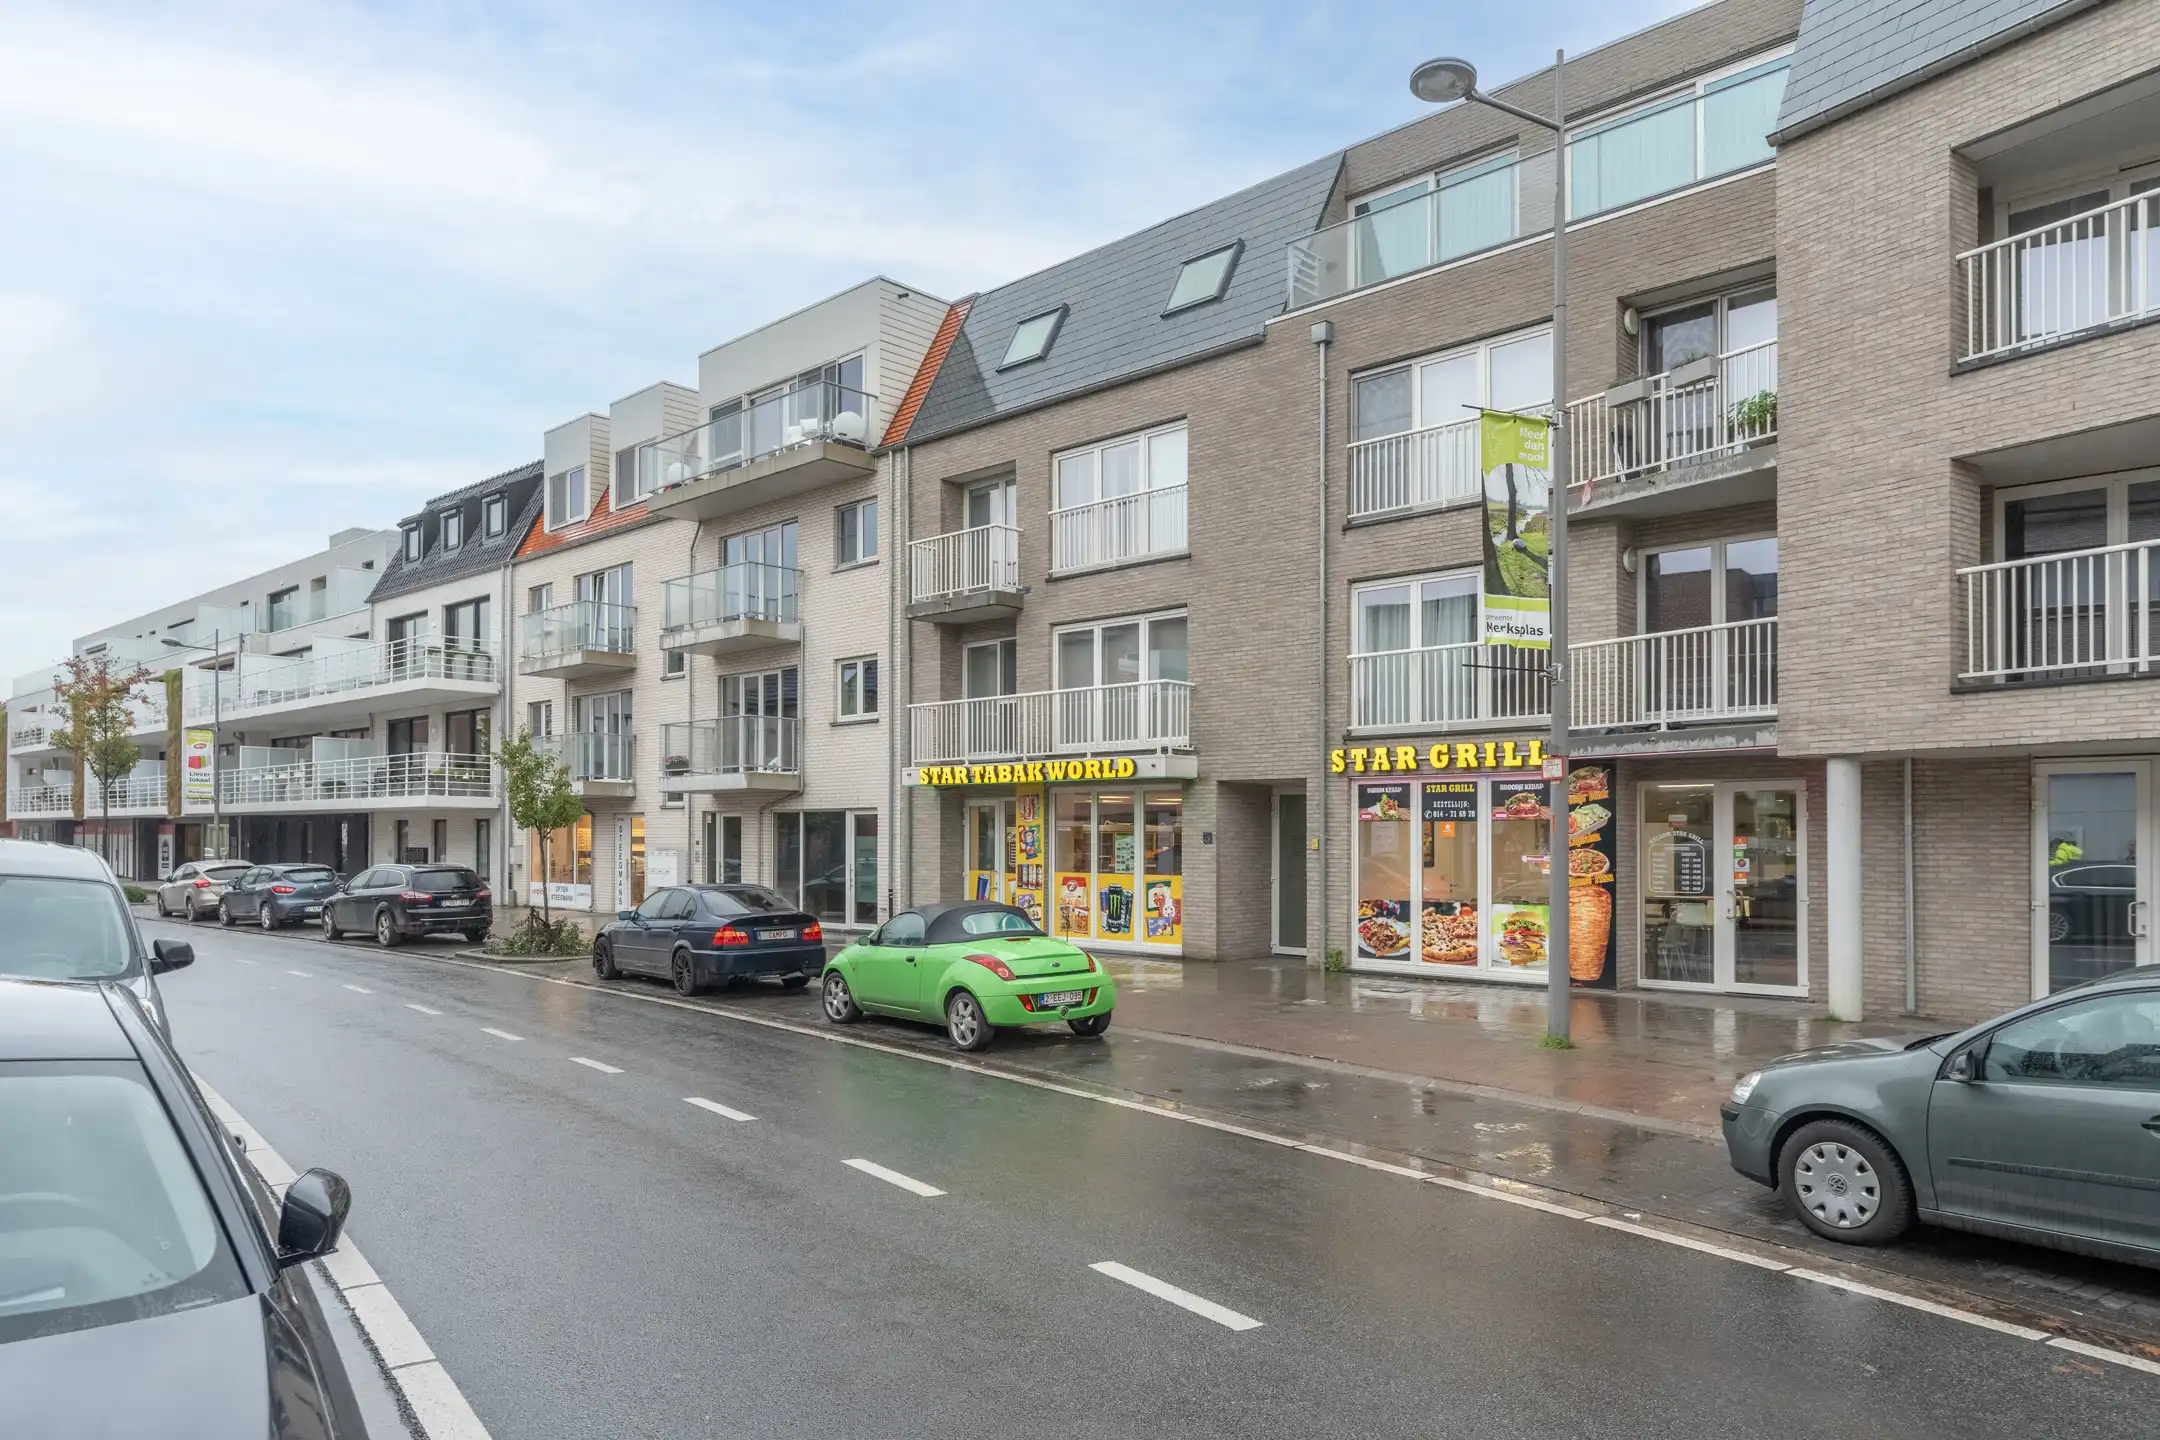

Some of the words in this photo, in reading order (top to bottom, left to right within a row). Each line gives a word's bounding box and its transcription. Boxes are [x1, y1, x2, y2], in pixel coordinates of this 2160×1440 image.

[1520, 427, 1545, 439] Meer
[1524, 439, 1545, 451] dan
[1518, 451, 1545, 462] mooi
[1331, 745, 1418, 773] STAR
[1429, 739, 1549, 769] GRILL
[919, 766, 969, 785] STAR
[972, 762, 1044, 784] TABAK
[1045, 758, 1137, 781] WORLD
[1425, 784, 1447, 793] STAR
[1449, 783, 1475, 793] GRILL
[1499, 783, 1524, 792] BROODJE
[1433, 810, 1444, 818] 014
